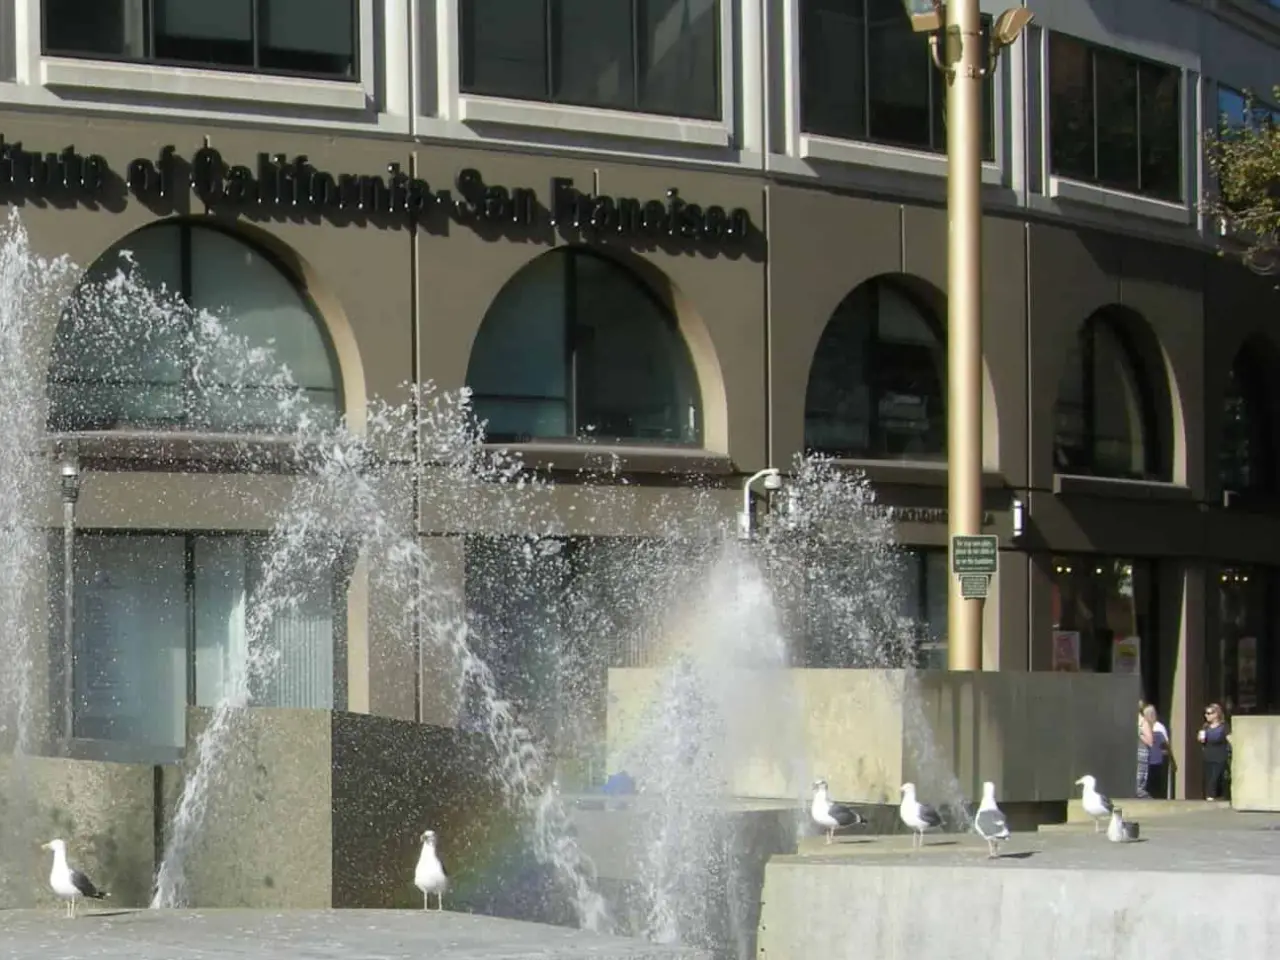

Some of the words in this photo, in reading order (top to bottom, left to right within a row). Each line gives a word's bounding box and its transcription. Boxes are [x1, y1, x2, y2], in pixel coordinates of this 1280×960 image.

[127, 145, 175, 195] of
[190, 147, 430, 212] California
[455, 168, 532, 222] San
[551, 177, 749, 235] Francisco
